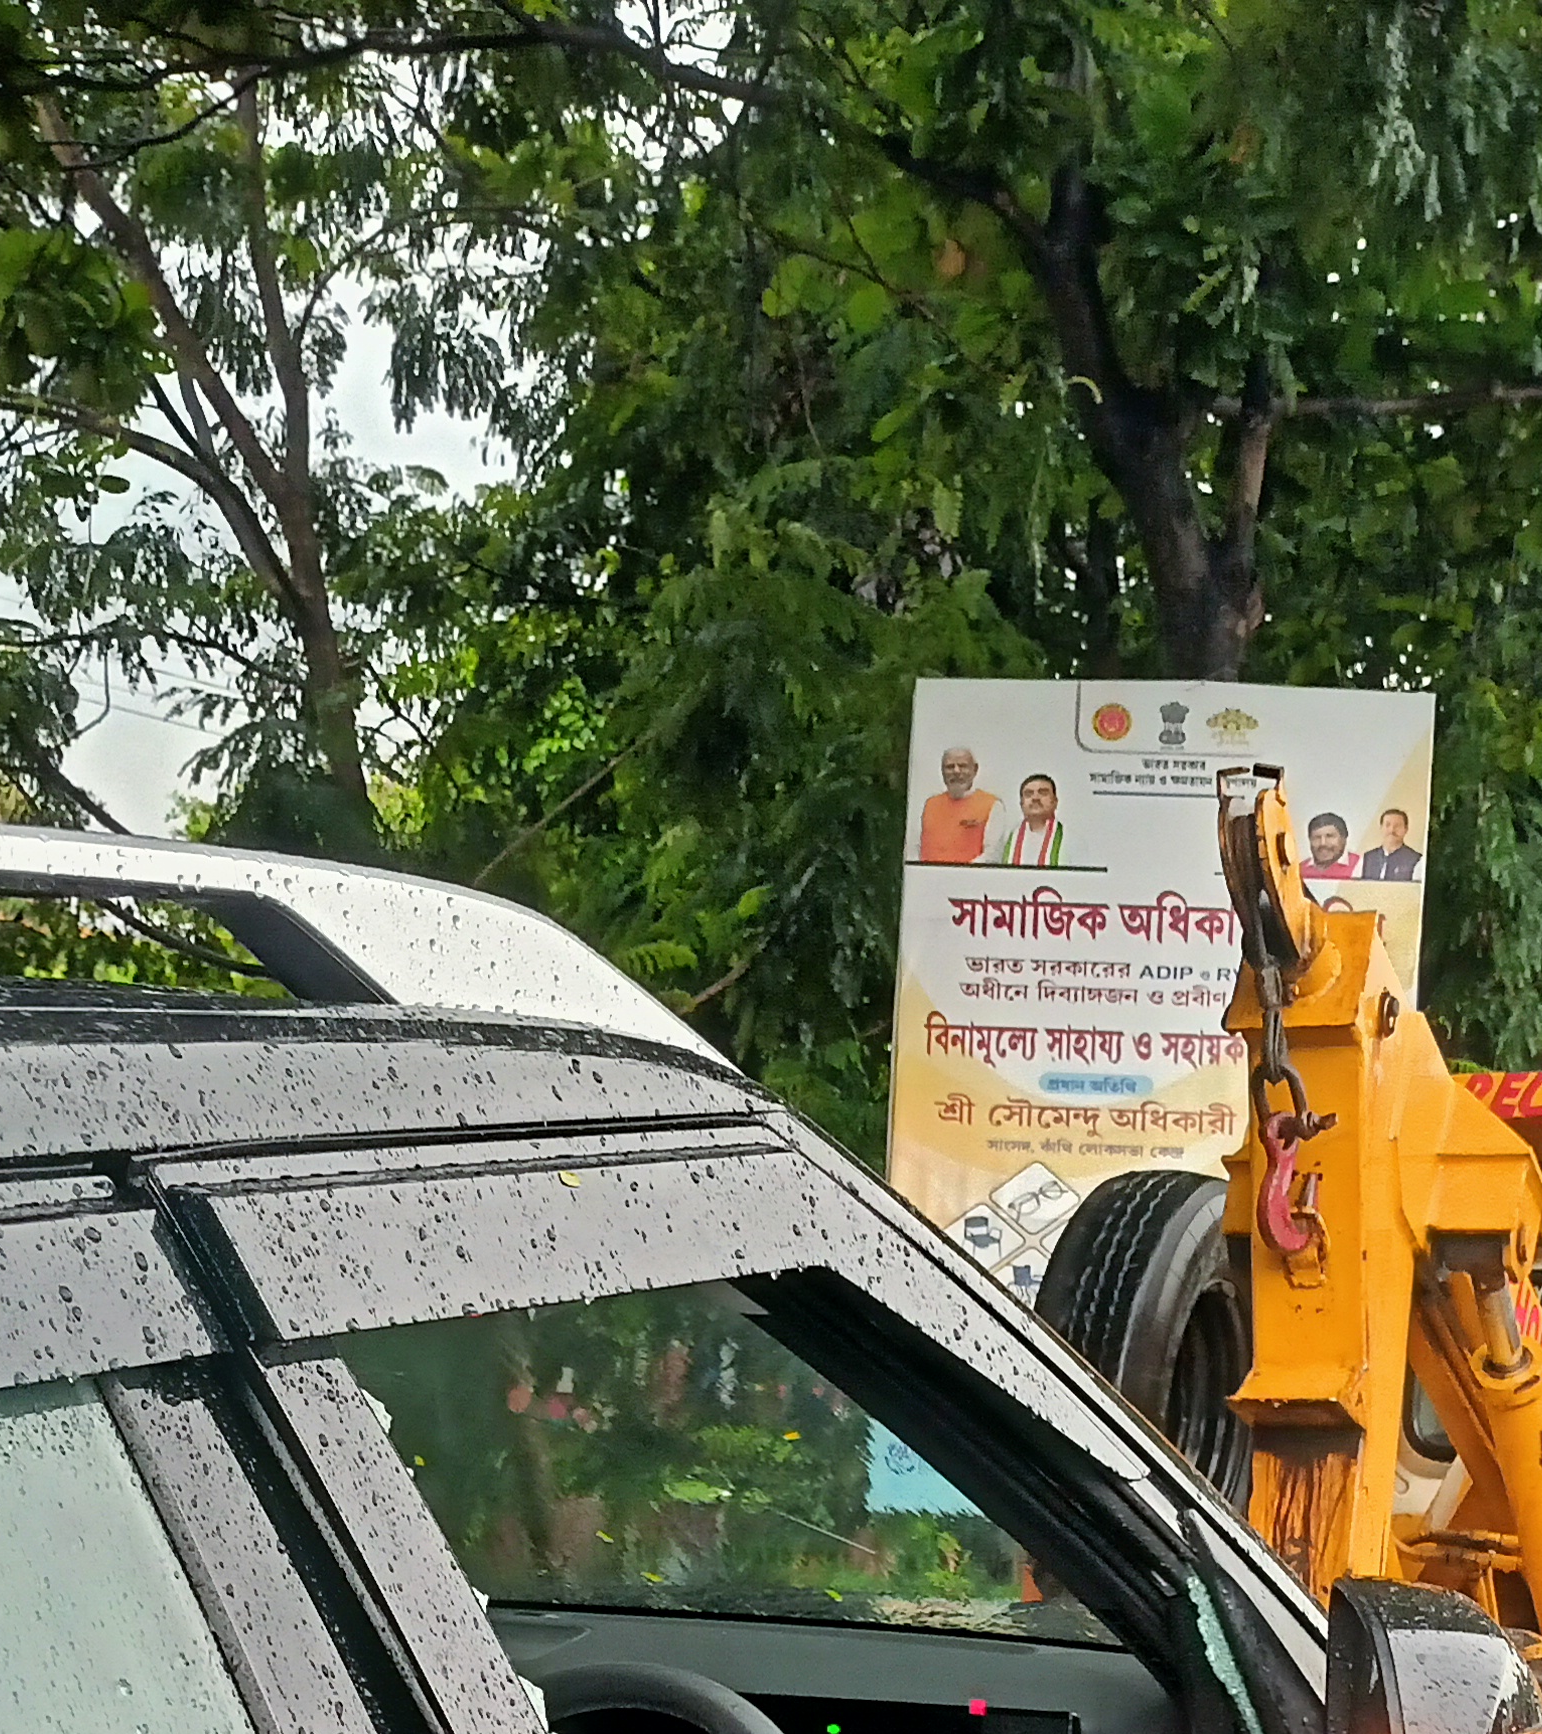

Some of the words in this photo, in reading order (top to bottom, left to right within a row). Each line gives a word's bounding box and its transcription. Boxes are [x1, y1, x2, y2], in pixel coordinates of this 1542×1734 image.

[948, 886, 1110, 941] সামাজিক
[1118, 891, 1238, 946] অধিকা
[965, 956, 1025, 975] ভারত
[1031, 959, 1131, 979] সরকারের
[1139, 966, 1193, 981] ADIP
[959, 977, 1029, 1003] অধীনে
[1147, 989, 1164, 1005] ও
[1171, 983, 1227, 1008] প্রবীণ
[924, 1011, 1038, 1069] বিনামূল্যে
[1045, 1024, 1124, 1064] সাহায্য
[1132, 1032, 1152, 1061] ও
[934, 1093, 976, 1126] শ্রী
[988, 1096, 1101, 1138] সৌমেন্দু
[1109, 1100, 1238, 1137] অধিকারী
